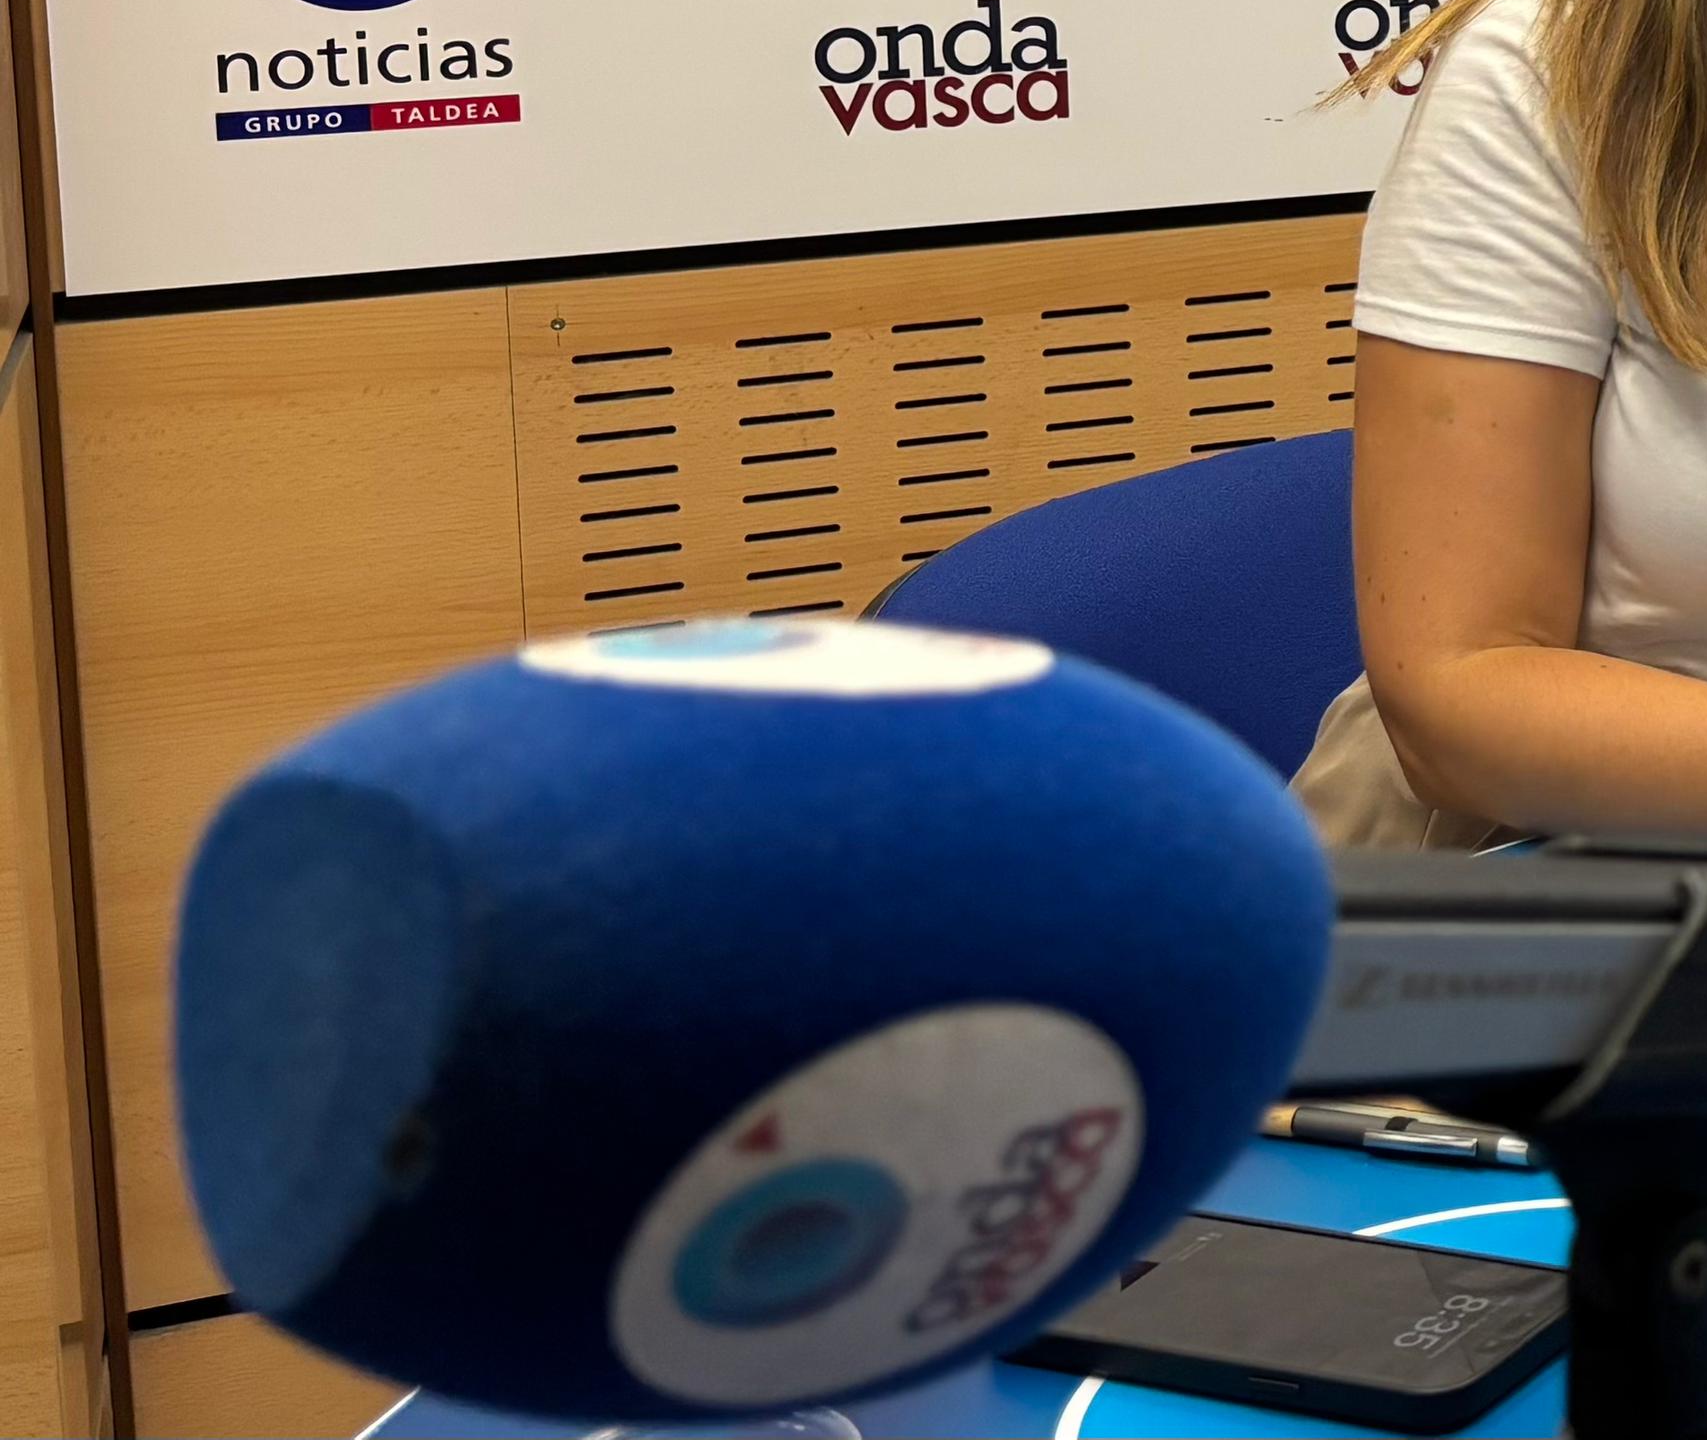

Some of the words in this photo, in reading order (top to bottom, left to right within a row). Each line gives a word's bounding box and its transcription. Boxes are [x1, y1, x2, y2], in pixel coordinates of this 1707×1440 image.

[217, 27, 513, 93] noticias
[244, 108, 344, 135] GRUPO
[391, 99, 501, 125] TALDEA
[818, 70, 1069, 136] vasca
[1393, 1295, 1489, 1350] 8:35
